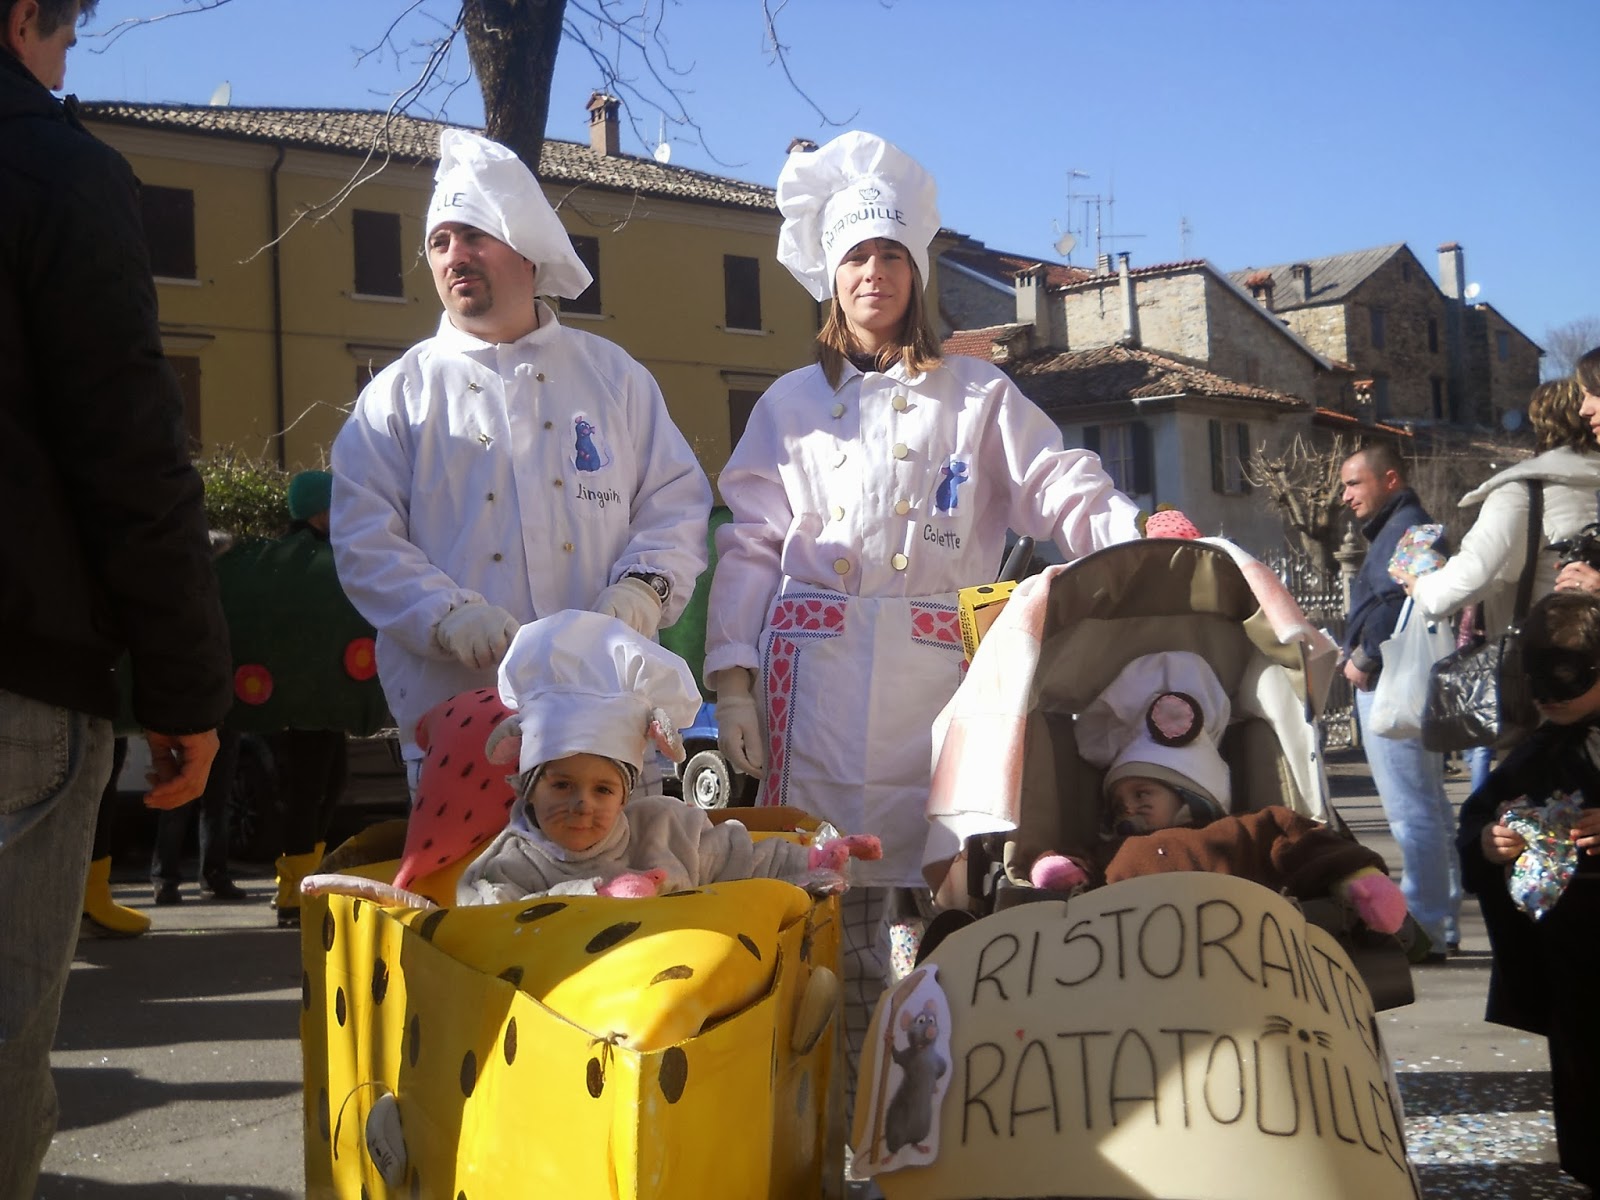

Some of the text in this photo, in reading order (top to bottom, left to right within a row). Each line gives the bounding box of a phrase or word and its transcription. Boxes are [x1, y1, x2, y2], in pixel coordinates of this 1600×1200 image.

[923, 524, 961, 550] Colette
[971, 899, 1379, 1062] RISTORANTE
[961, 1027, 1405, 1174] RATATOUILLE
